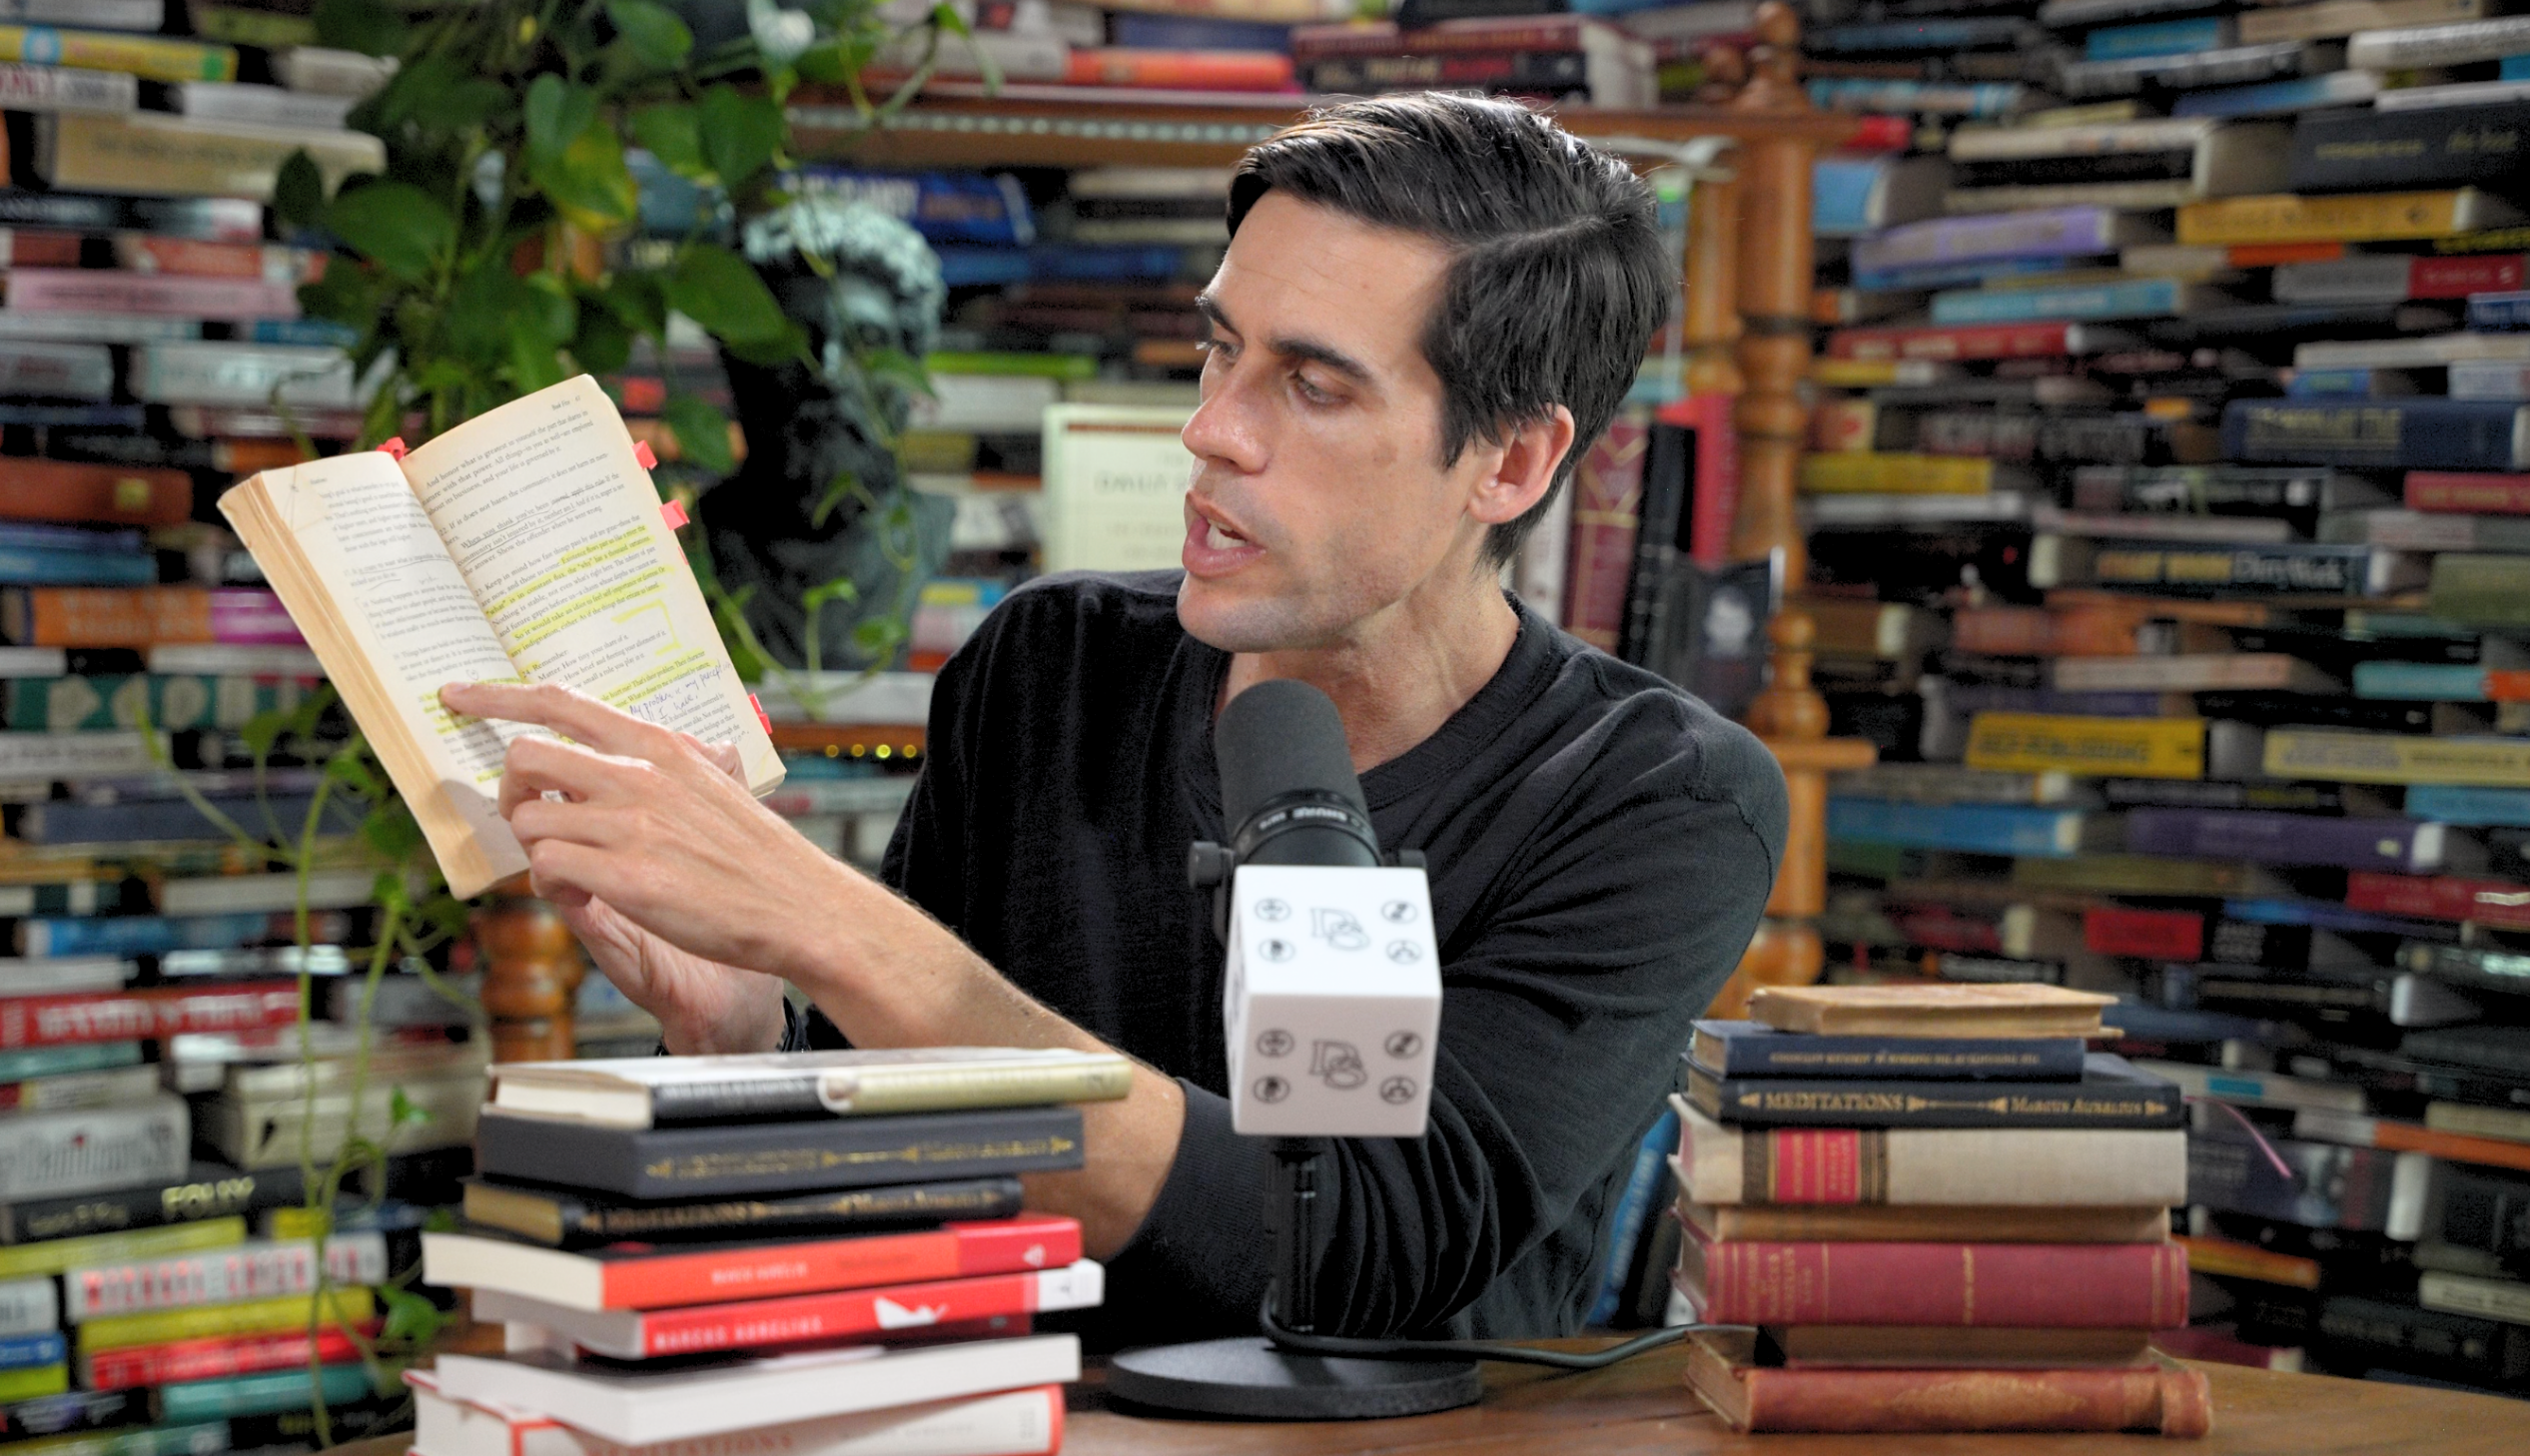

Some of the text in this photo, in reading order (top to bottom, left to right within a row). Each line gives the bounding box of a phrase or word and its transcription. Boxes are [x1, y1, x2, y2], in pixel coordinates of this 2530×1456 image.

[1766, 1092, 1904, 1112] MEDITATIONS
[654, 1324, 728, 1350] MARCUS
[733, 1315, 823, 1342] AURELIUS
